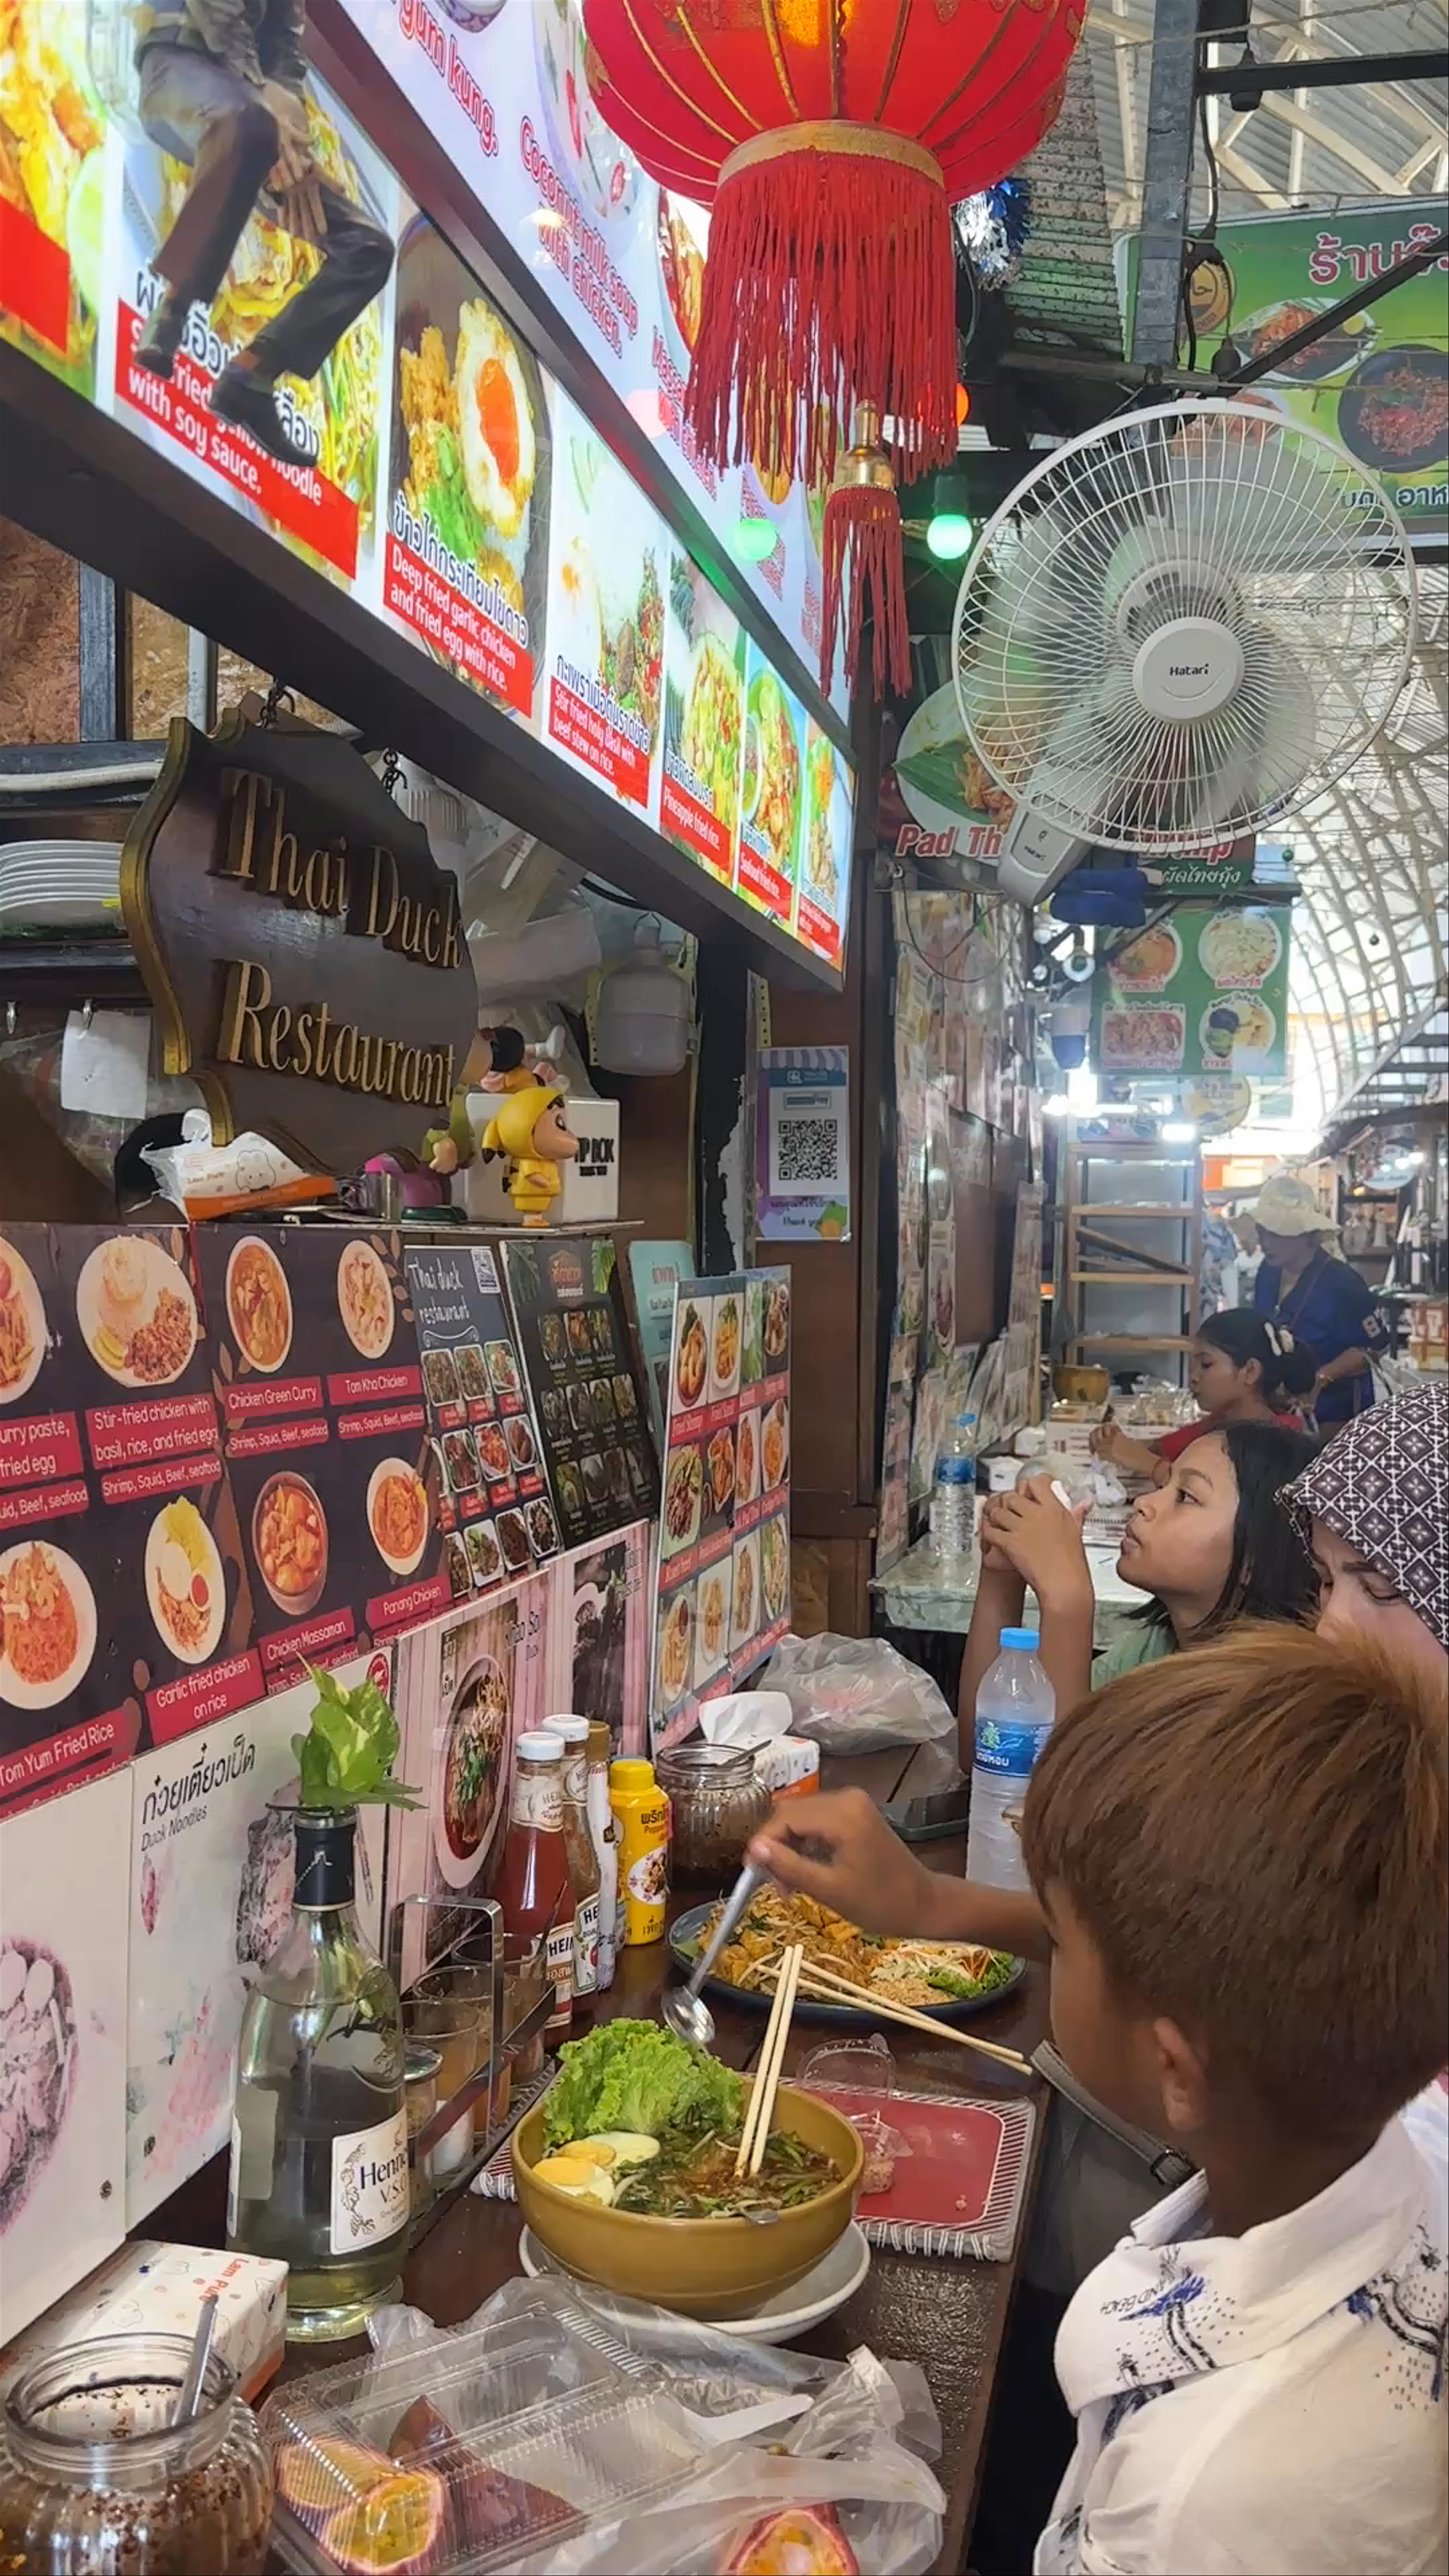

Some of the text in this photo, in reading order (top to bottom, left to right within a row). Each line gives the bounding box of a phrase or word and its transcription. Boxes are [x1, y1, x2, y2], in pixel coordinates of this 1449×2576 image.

[448, 34, 498, 157] kung.
[609, 265, 638, 340] soup
[170, 353, 214, 414] ried
[129, 367, 171, 421] with
[175, 408, 208, 458] soy
[392, 544, 515, 669] Deep fried garlic chicken
[391, 583, 508, 691] and fried egg with rice.
[1170, 663, 1209, 676] Hatari
[569, 698, 589, 731] fried
[553, 711, 571, 740] beef
[571, 727, 590, 756] stew
[589, 746, 600, 766] on
[895, 824, 956, 857] Pad
[229, 771, 463, 969] Thai Duck
[229, 959, 455, 1109] Restaurant
[229, 1386, 317, 1410] Chicken Green Curry
[345, 1380, 362, 1395] Tom
[378, 1375, 408, 1390] Chicken
[30, 1419, 70, 1444] paste,
[94, 1397, 211, 1430] Stir-fried chicken with
[301, 1424, 328, 1438] seafood
[95, 1427, 219, 1462] basil, rice, and fried egg
[34, 1454, 56, 1476] egg
[102, 1459, 221, 1497] Shrimp, Squid, Beef, seafood
[20, 1493, 48, 1515] Beef,
[49, 1487, 88, 1509] seafood
[383, 1586, 441, 1616] Panang Chicken
[267, 1638, 301, 1660] Chicken
[301, 1620, 346, 1647] Massaman
[155, 1685, 189, 1708] Garlic
[188, 1667, 213, 1695] fried
[214, 1657, 251, 1684] chicken
[194, 1693, 227, 1721] on rice
[0, 1761, 25, 1787] Tom
[24, 1750, 54, 1774] Yum
[54, 1730, 89, 1762] Fried
[88, 1723, 114, 1746] Rice
[141, 1804, 208, 1852] Duck Noodles
[360, 2152, 406, 2190] Henn
